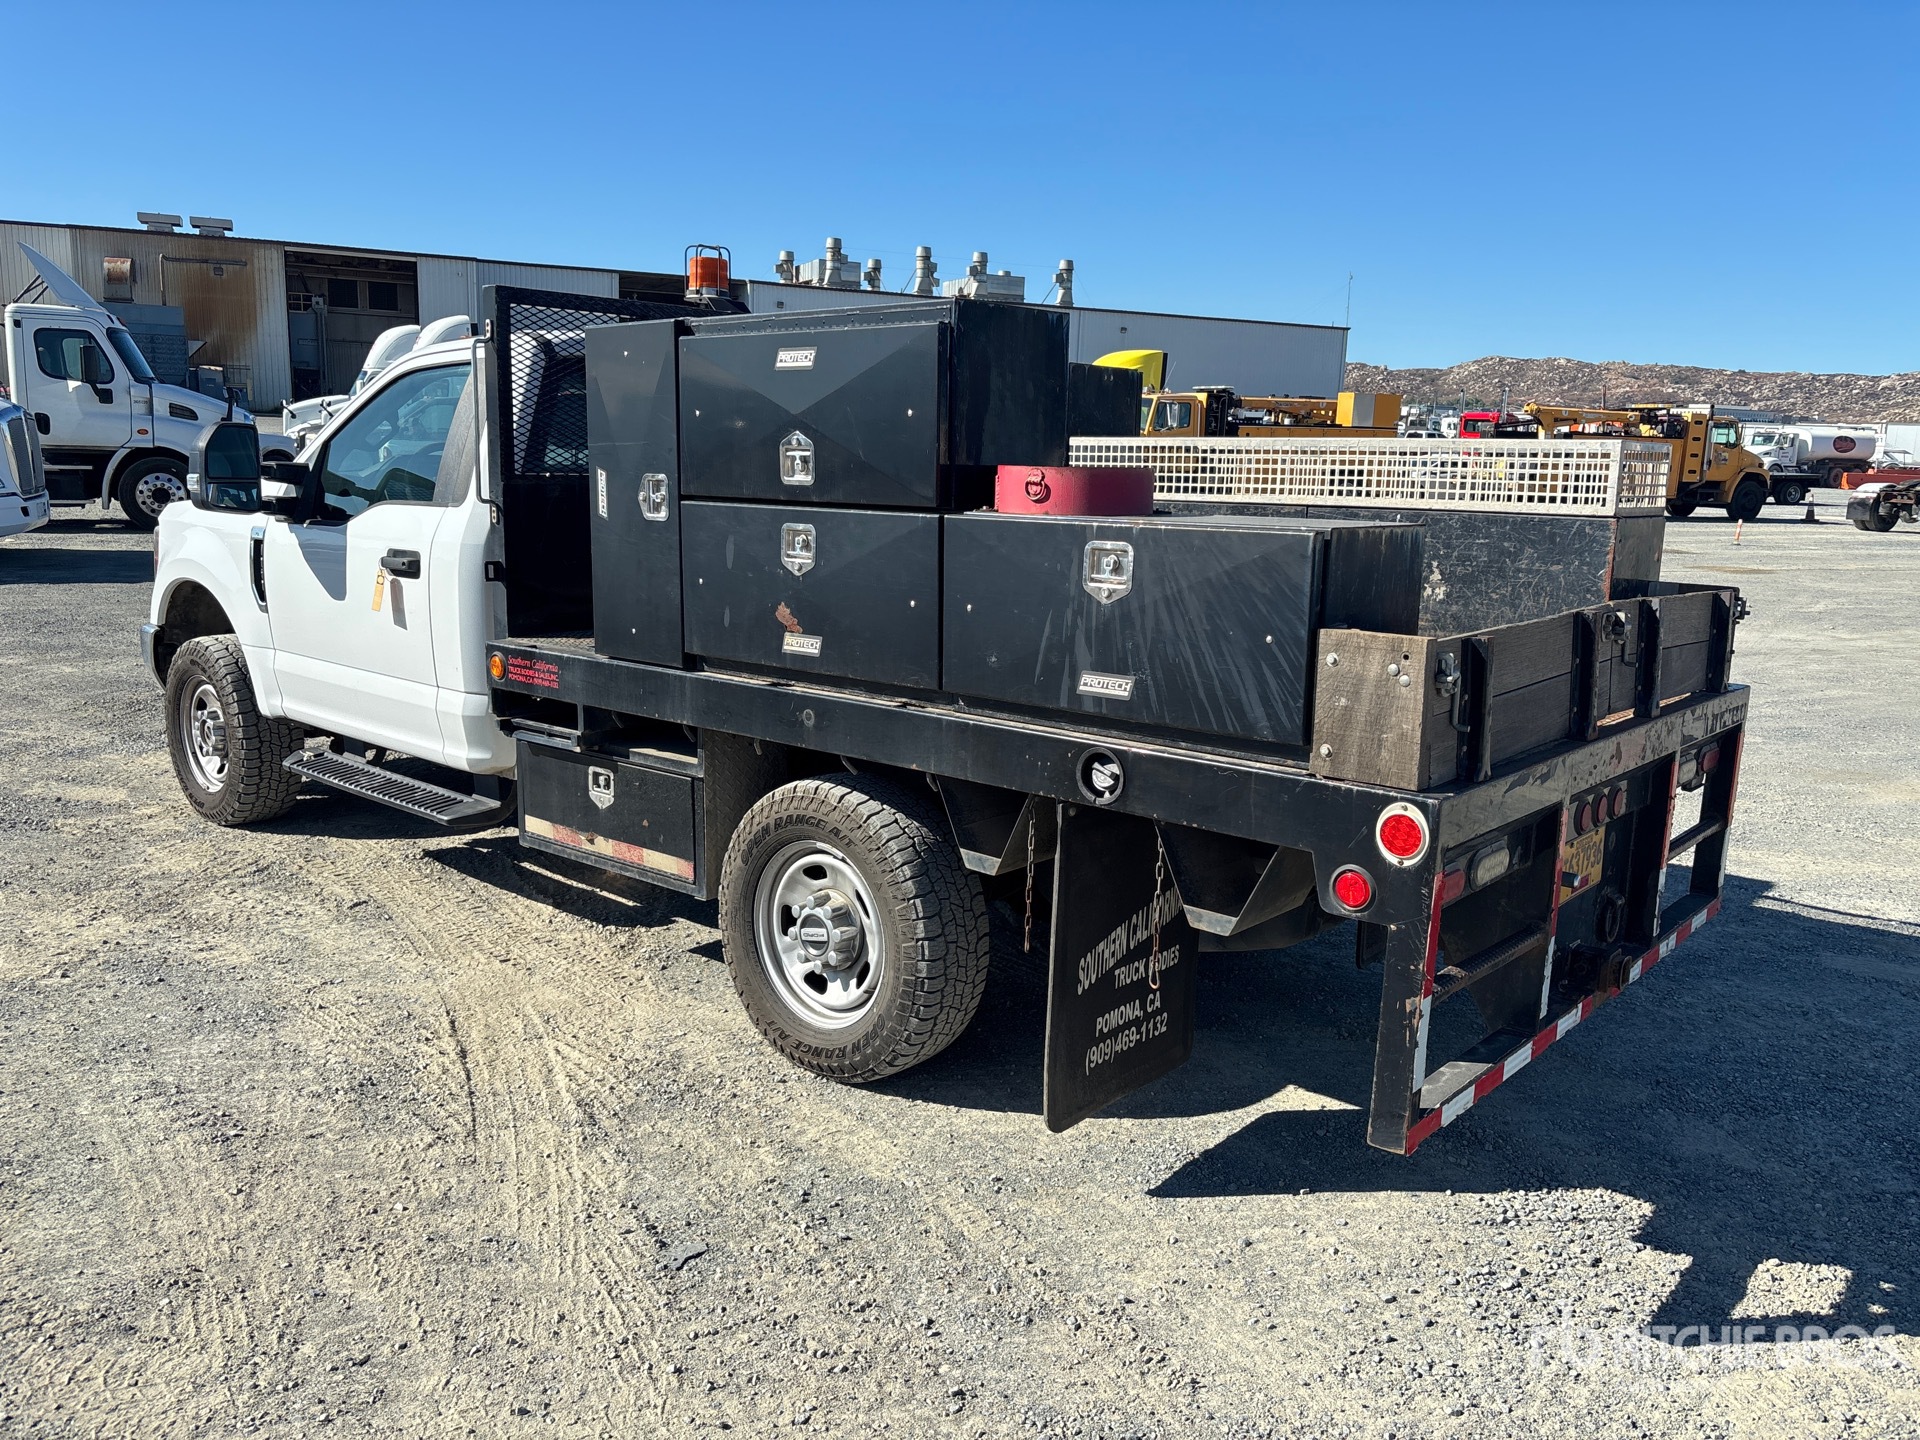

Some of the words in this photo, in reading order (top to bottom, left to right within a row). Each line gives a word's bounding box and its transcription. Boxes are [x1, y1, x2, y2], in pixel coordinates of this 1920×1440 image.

[778, 352, 815, 362] PROTECH
[785, 637, 821, 649] PROTECH
[508, 655, 531, 667] Southern
[532, 659, 558, 672] California
[1081, 676, 1132, 691] PROTECH
[741, 822, 771, 866] OPEN
[773, 813, 828, 832] RANGE
[1077, 919, 1129, 996] SOUTHERN
[1114, 957, 1146, 989] TRUCK
[1095, 999, 1144, 1038] POMONA,
[1146, 990, 1161, 1013] CA
[790, 1038, 848, 1060] RANGE
[850, 1013, 886, 1057] OPEN
[1085, 1012, 1168, 1076] (909)469-1132
